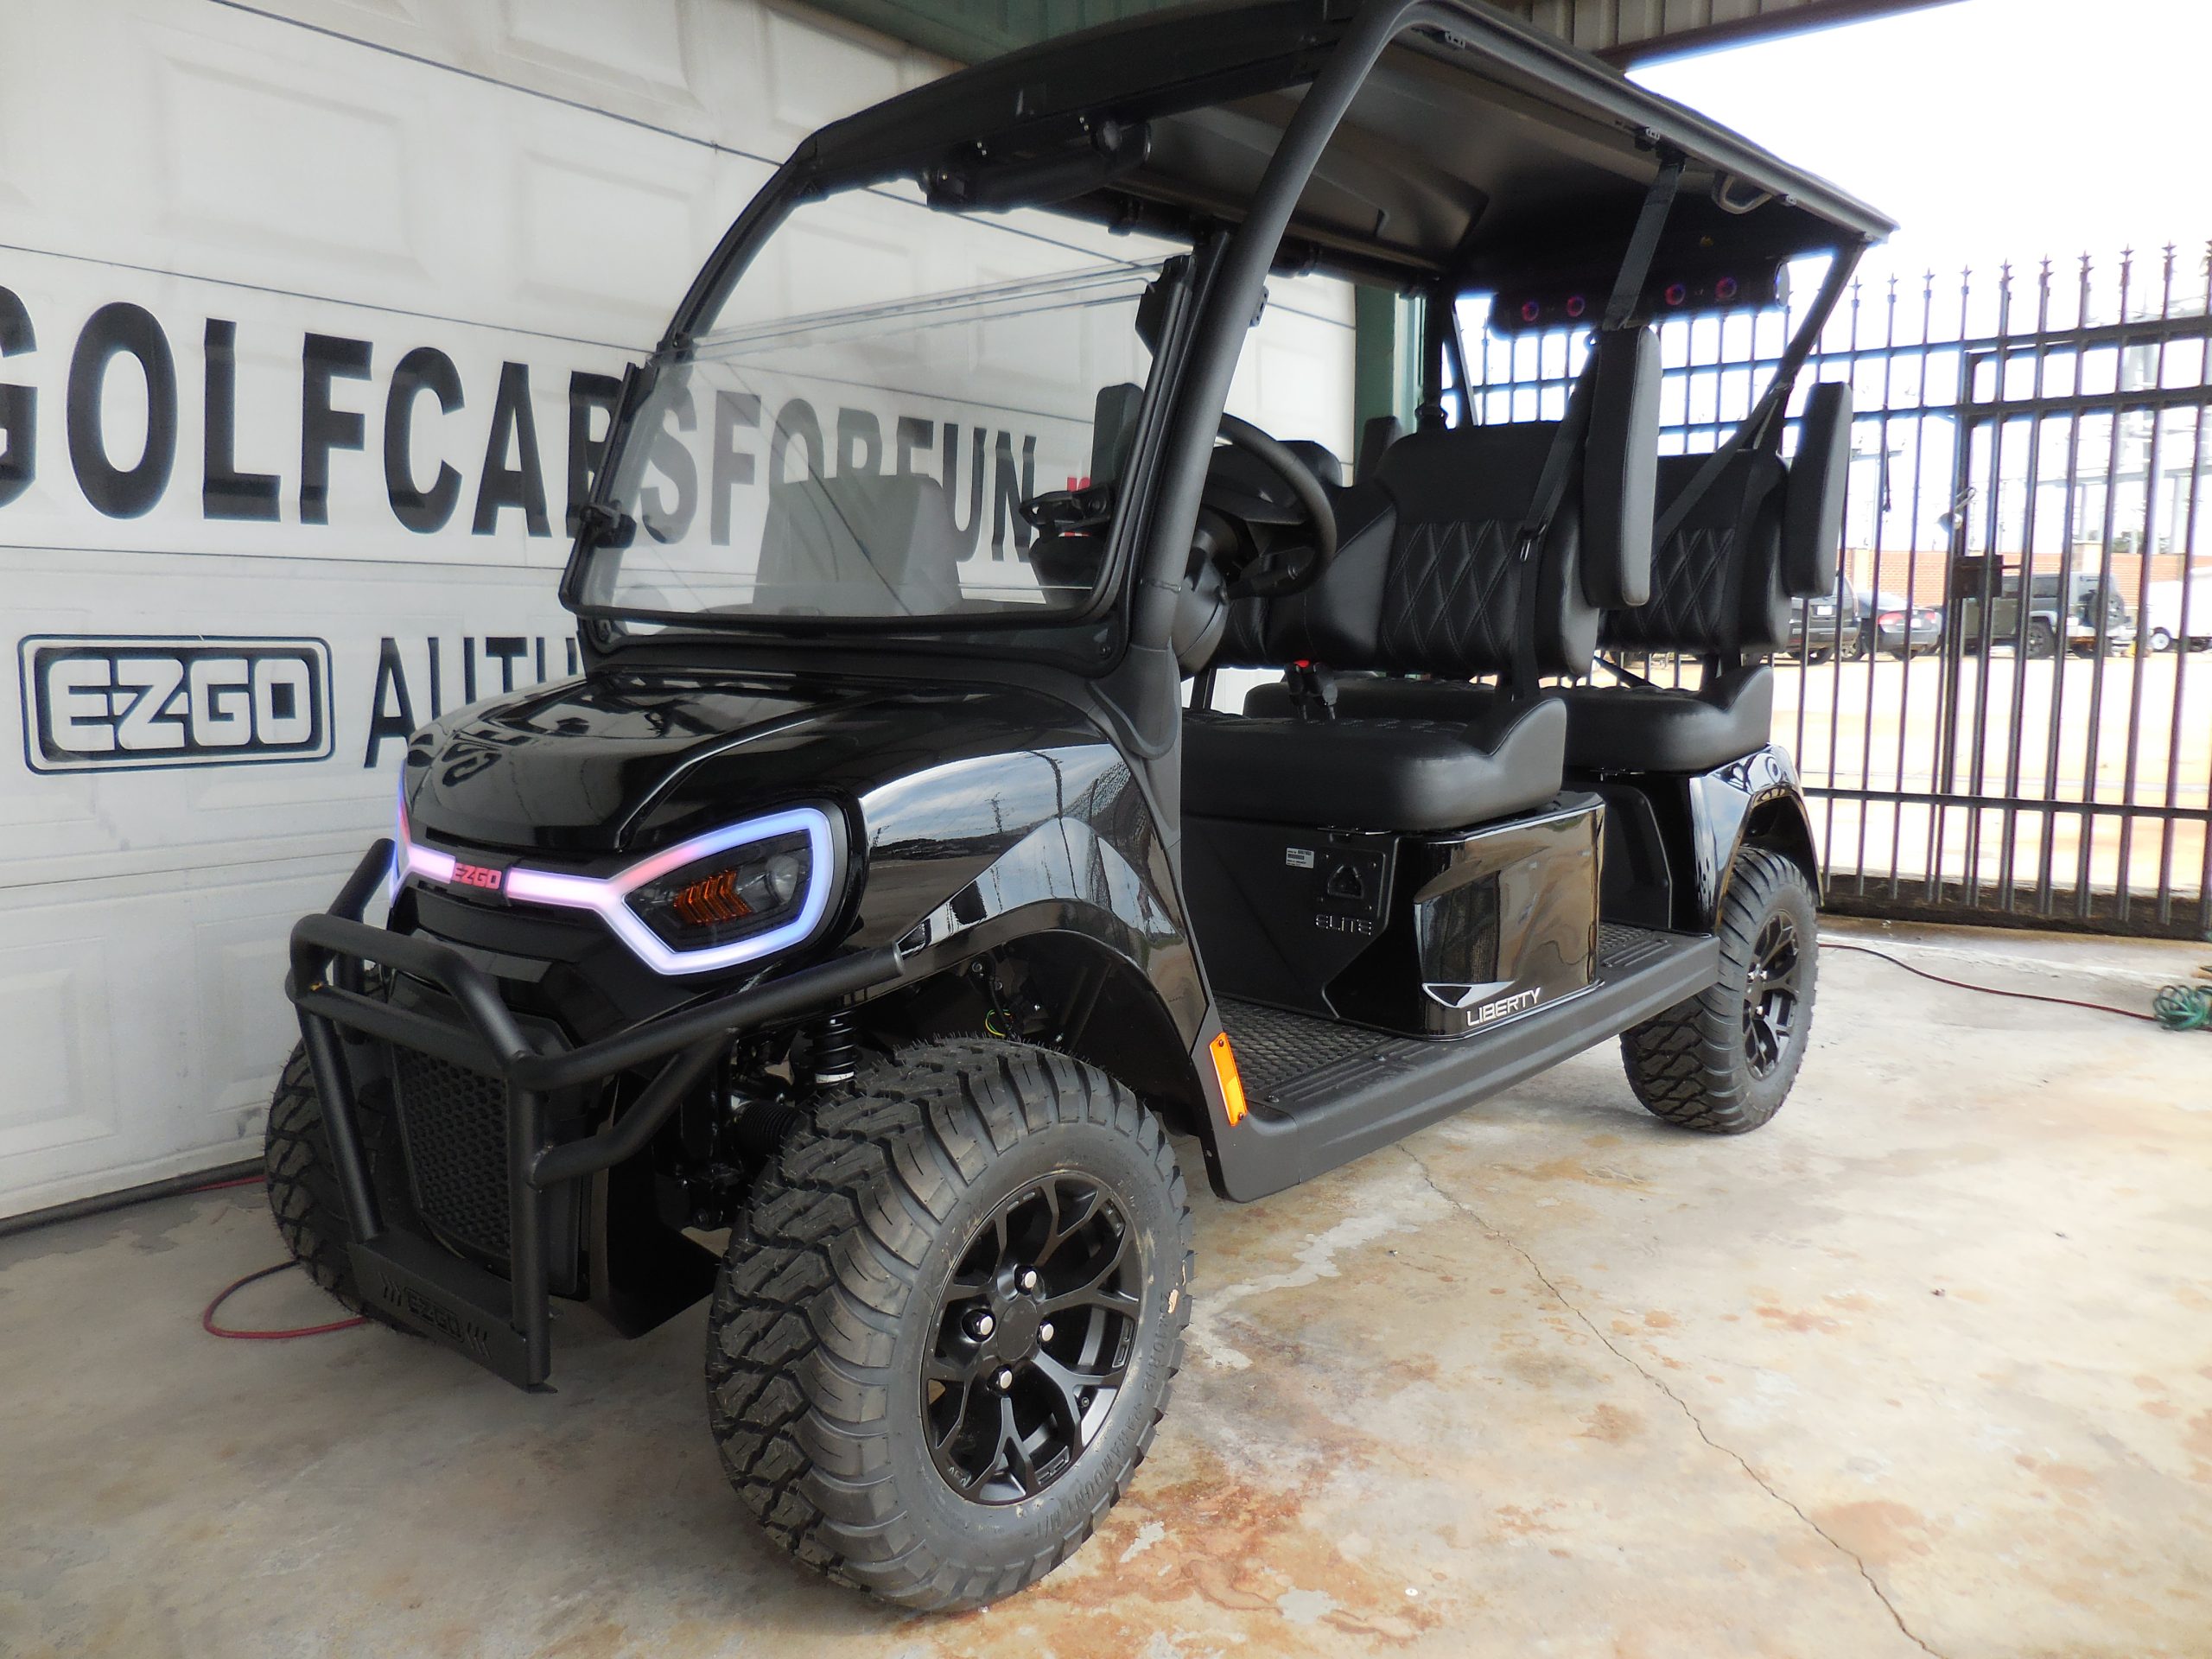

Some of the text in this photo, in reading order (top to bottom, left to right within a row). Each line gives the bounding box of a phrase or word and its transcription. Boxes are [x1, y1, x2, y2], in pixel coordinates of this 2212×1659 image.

[48, 658, 312, 751] EZGO
[452, 862, 502, 890] EZGO
[1467, 987, 1541, 1027] LIBERTY
